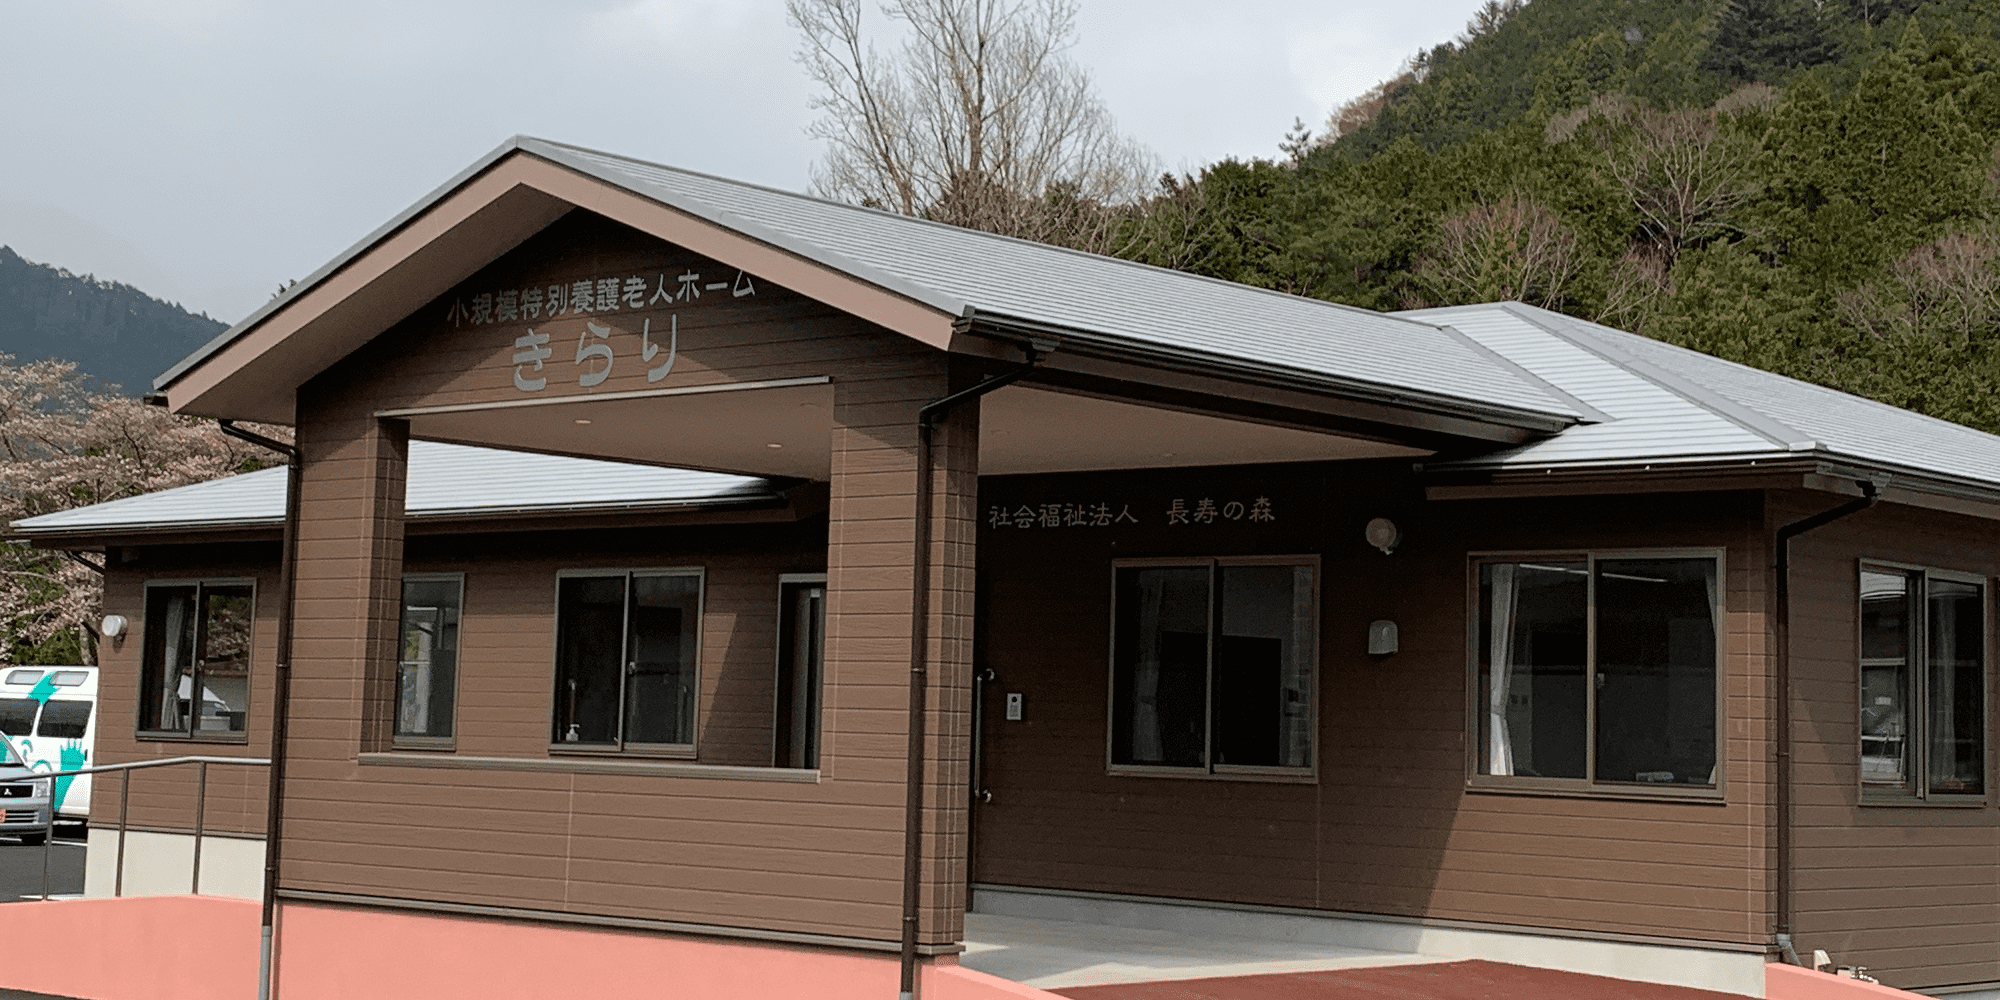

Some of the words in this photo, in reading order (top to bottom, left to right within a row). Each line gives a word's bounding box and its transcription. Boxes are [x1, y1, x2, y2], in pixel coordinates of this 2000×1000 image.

[447, 268, 756, 328] 小規模特別養護老人ホーム
[512, 313, 678, 392] きらり
[988, 502, 1139, 530] 社会福祉法人
[1166, 495, 1276, 526] 長寿の森
